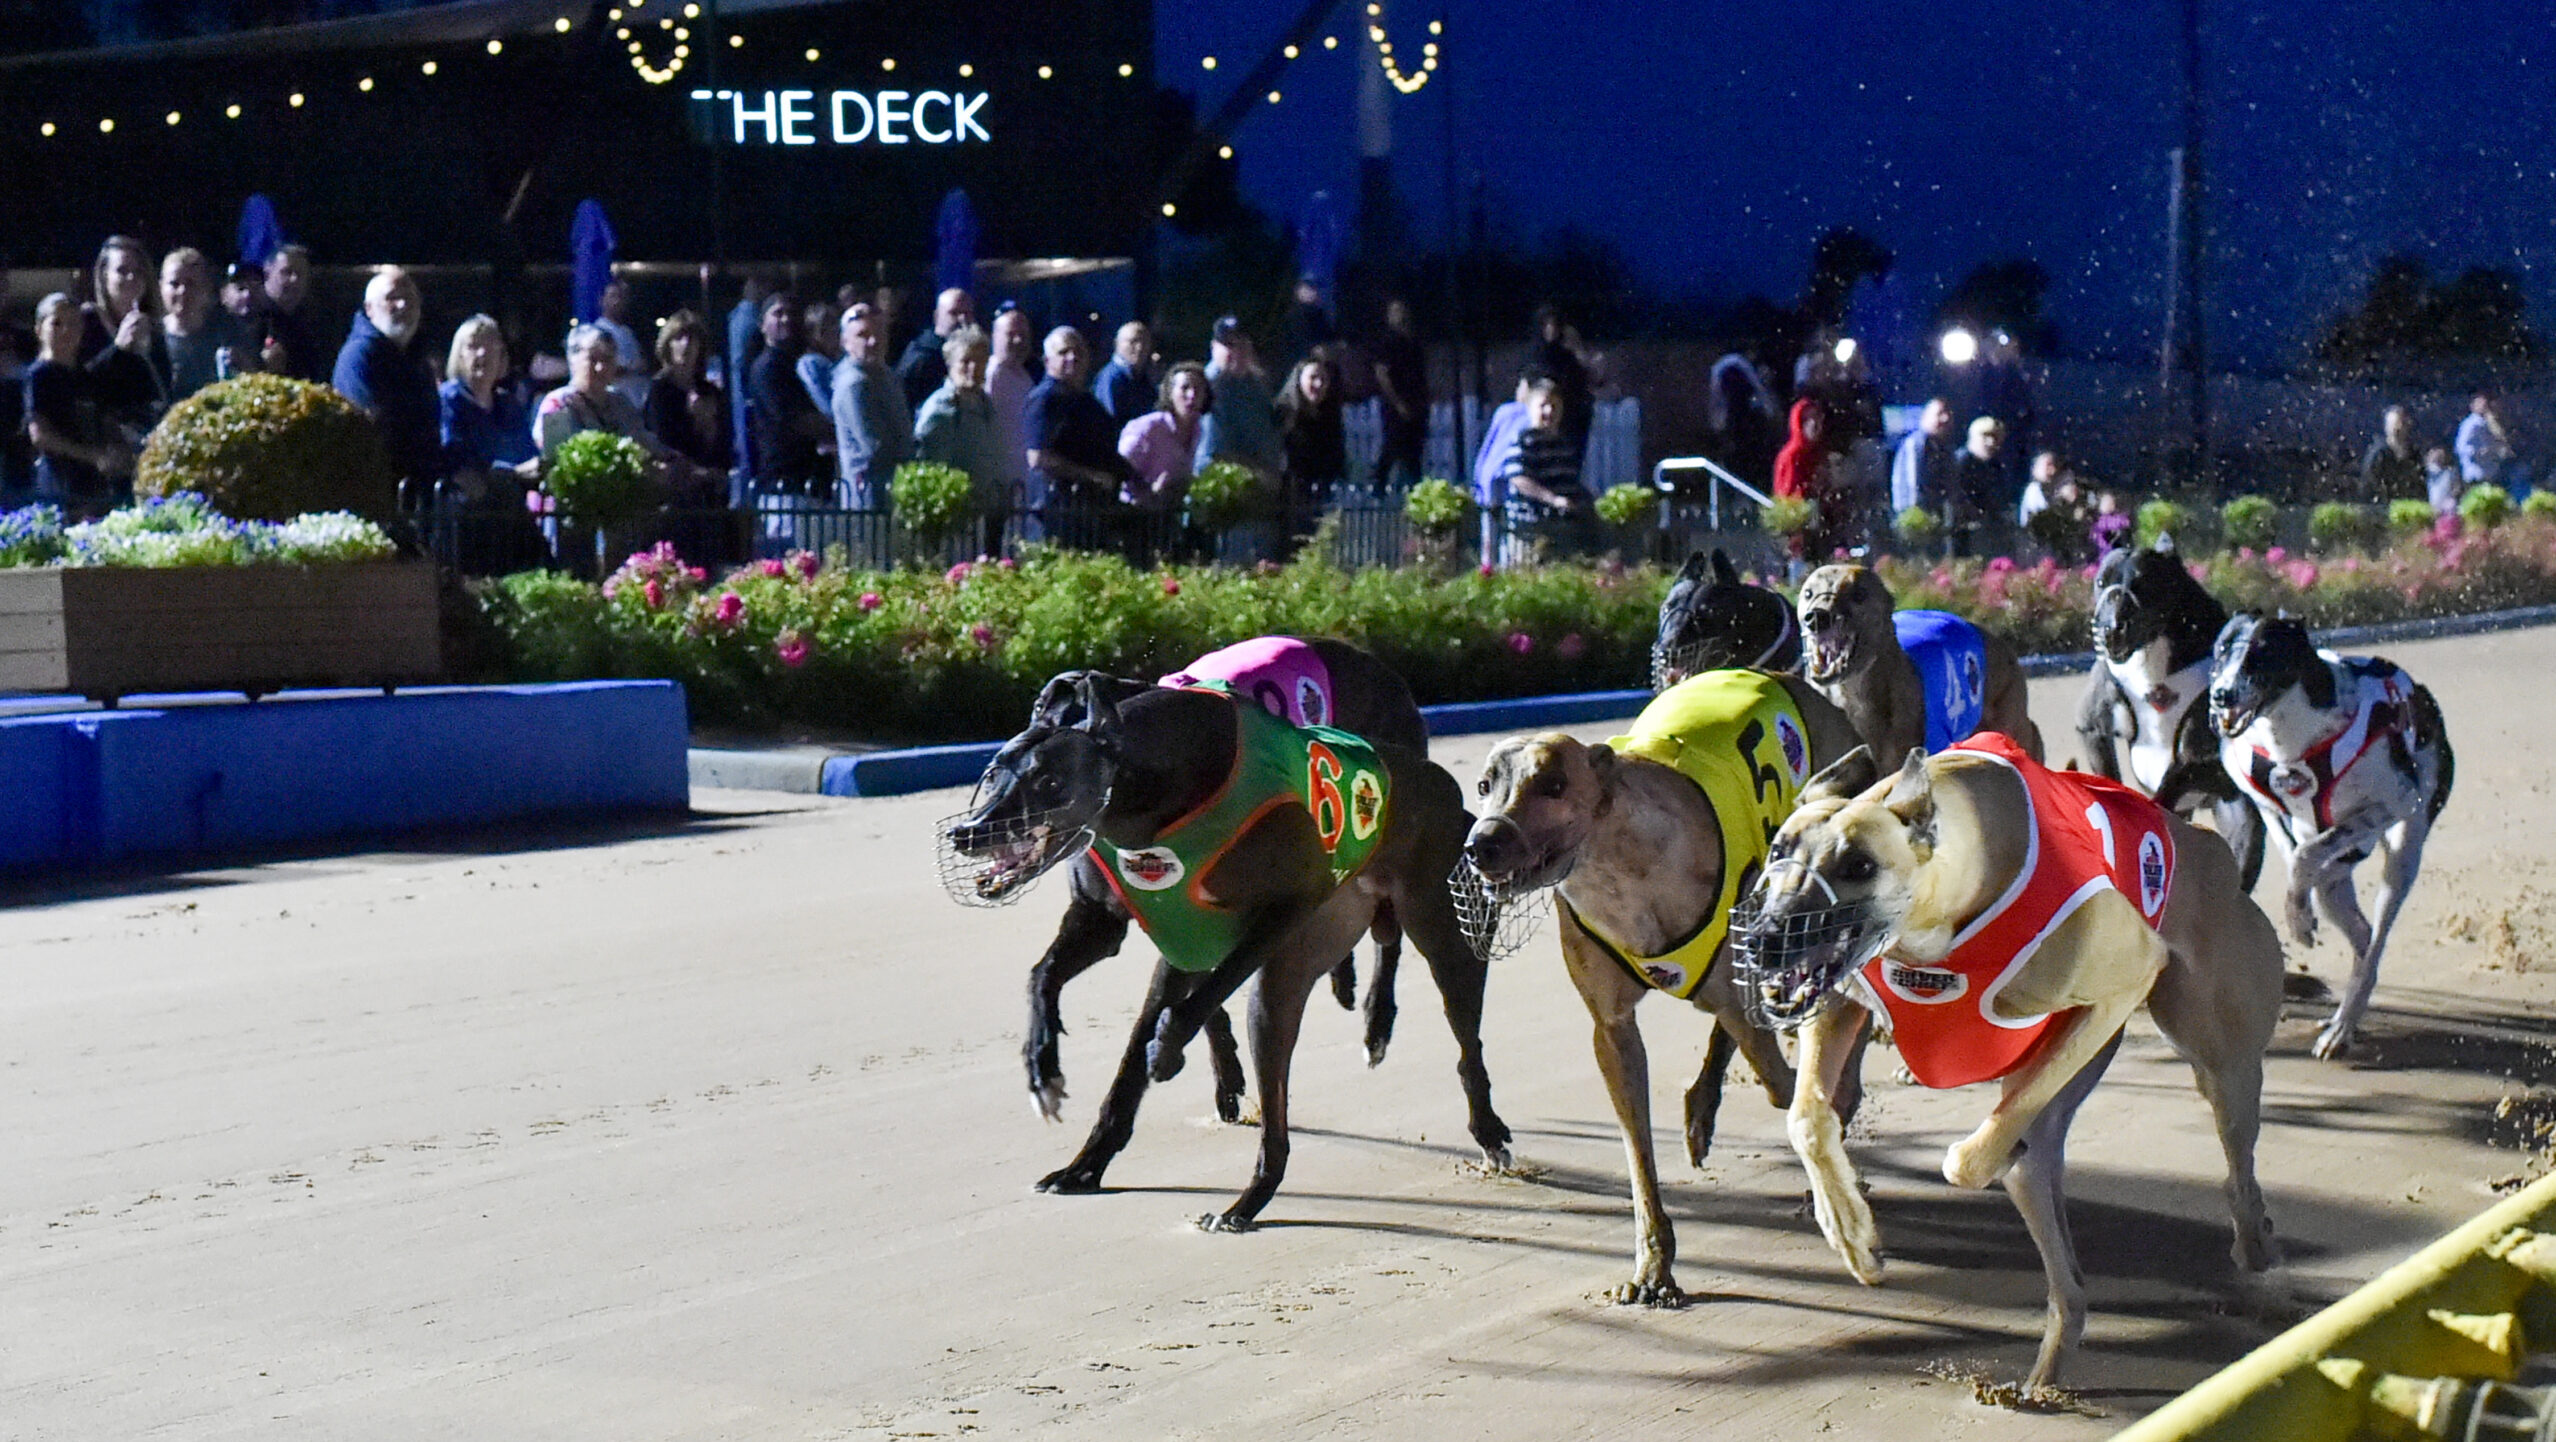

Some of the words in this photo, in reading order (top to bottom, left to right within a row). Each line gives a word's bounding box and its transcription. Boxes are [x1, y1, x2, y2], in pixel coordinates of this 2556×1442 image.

[831, 90, 991, 144] DECK
[1306, 740, 1345, 853] 6
[1736, 718, 1782, 846] 5
[2085, 801, 2116, 871] 1
